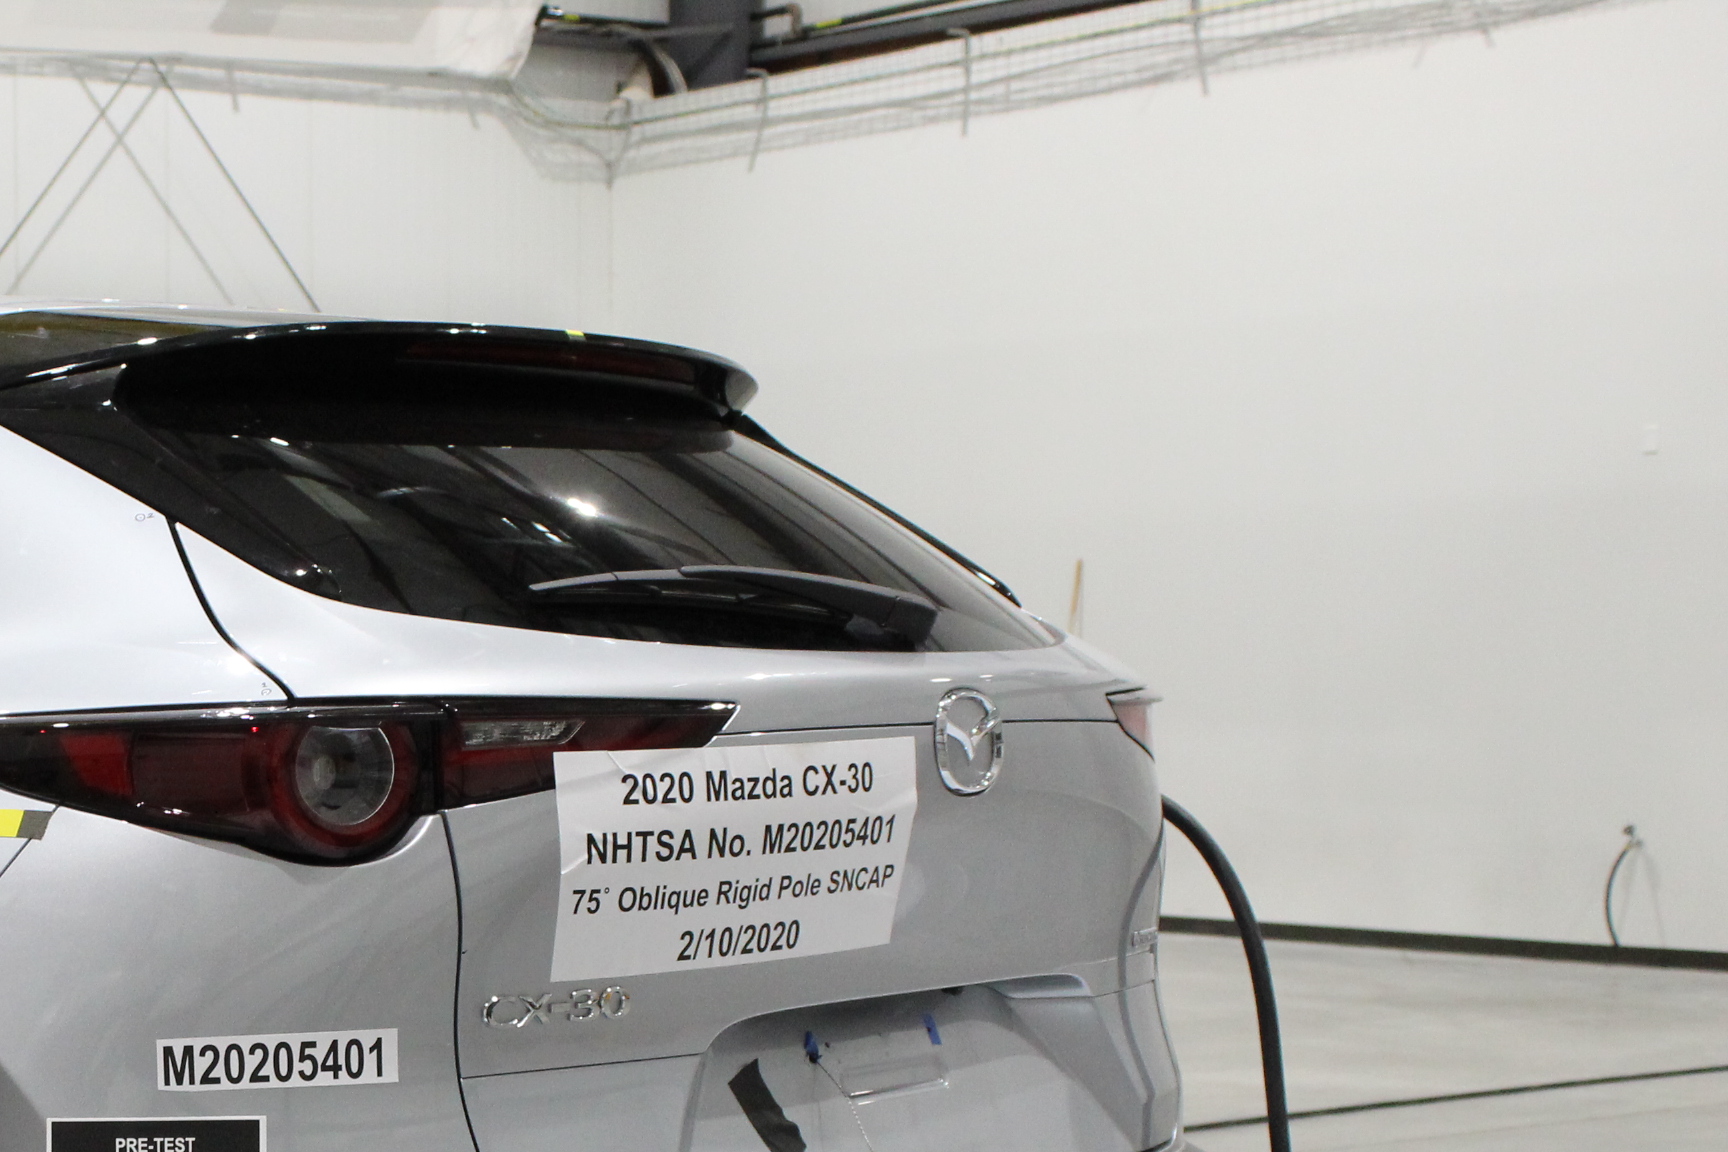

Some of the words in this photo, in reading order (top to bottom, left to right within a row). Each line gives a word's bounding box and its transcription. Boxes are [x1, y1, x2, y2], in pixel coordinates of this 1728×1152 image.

[622, 771, 694, 806] 2020
[705, 768, 794, 803] Mazda
[802, 761, 874, 796] CX-30
[586, 829, 698, 865] NHTSA
[707, 826, 753, 859] No.
[762, 813, 896, 856] M20205401
[618, 880, 709, 915] Oblique
[716, 875, 773, 911] Rigid
[777, 870, 822, 899] Pole
[827, 863, 895, 894] SNCAP
[677, 919, 801, 962] 2/10/2020
[482, 986, 632, 1028] CX-30
[162, 1037, 385, 1087] M20205401
